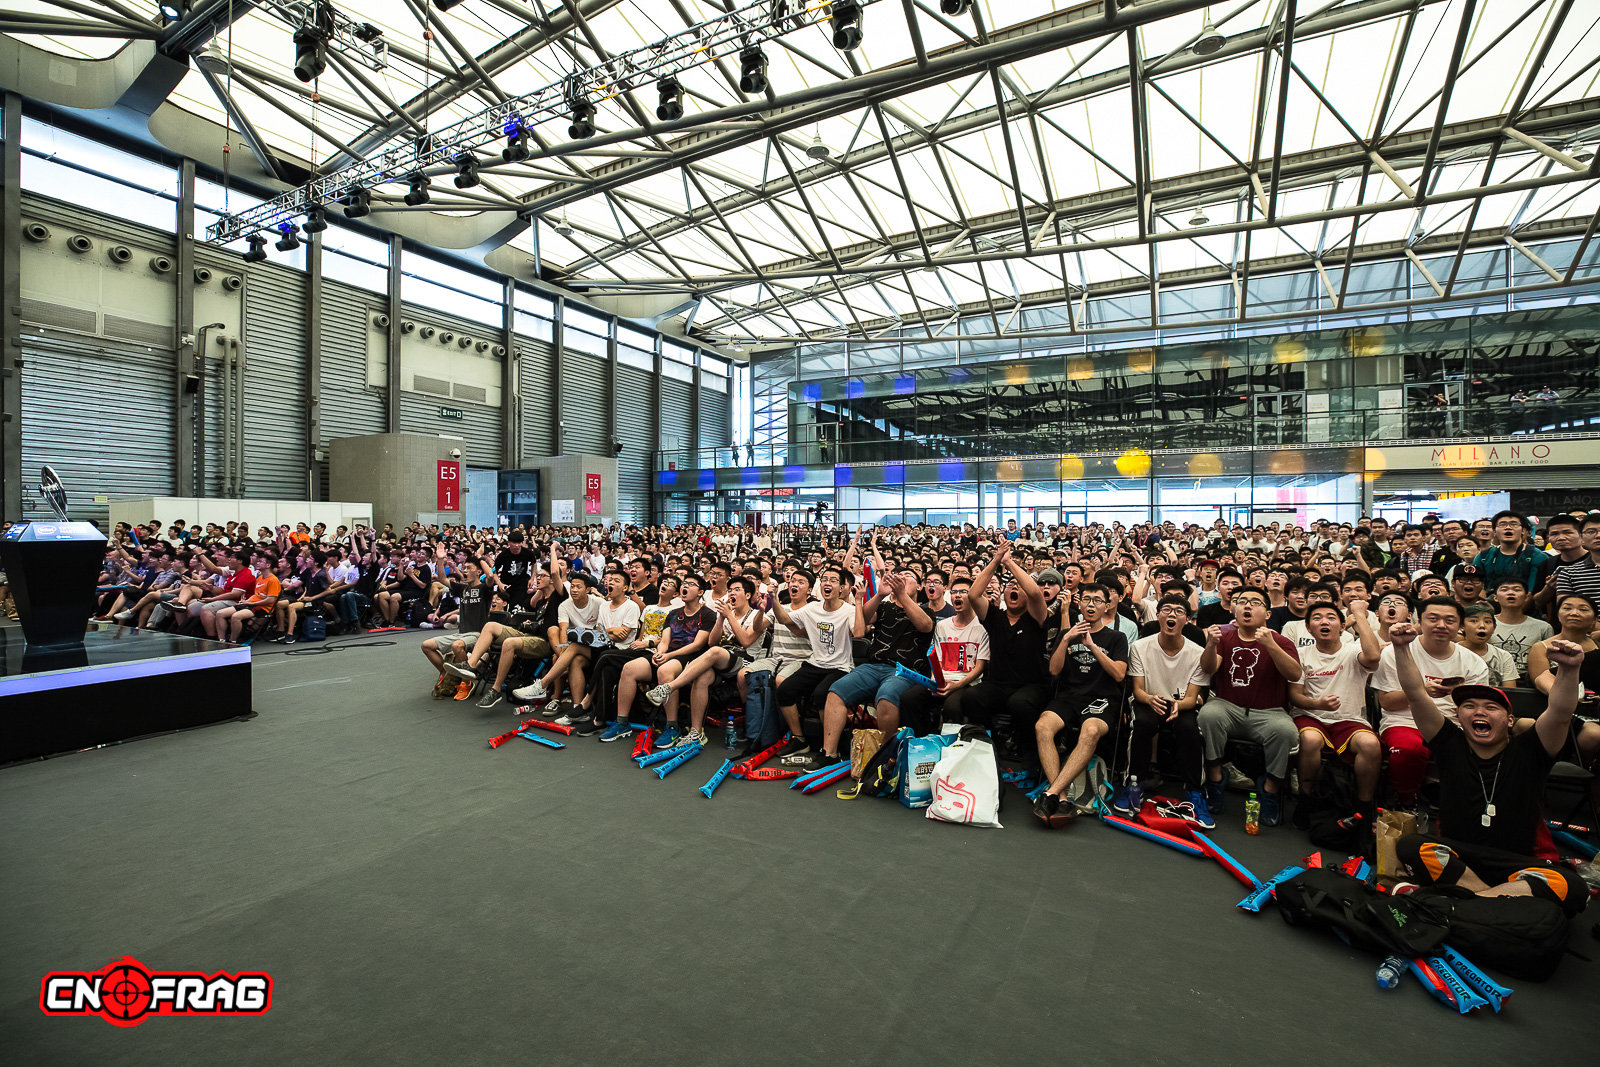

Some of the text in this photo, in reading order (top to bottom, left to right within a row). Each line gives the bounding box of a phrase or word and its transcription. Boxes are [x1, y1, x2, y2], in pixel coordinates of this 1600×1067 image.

[1431, 444, 1550, 461] MILANO
[441, 466, 456, 480] E5
[588, 478, 599, 489] E5
[445, 491, 451, 504] 1
[591, 499, 596, 509] 1
[1533, 494, 1593, 506] MILANO
[1431, 959, 1472, 1001] PREDATOR
[1455, 961, 1502, 1001] PREDATOR
